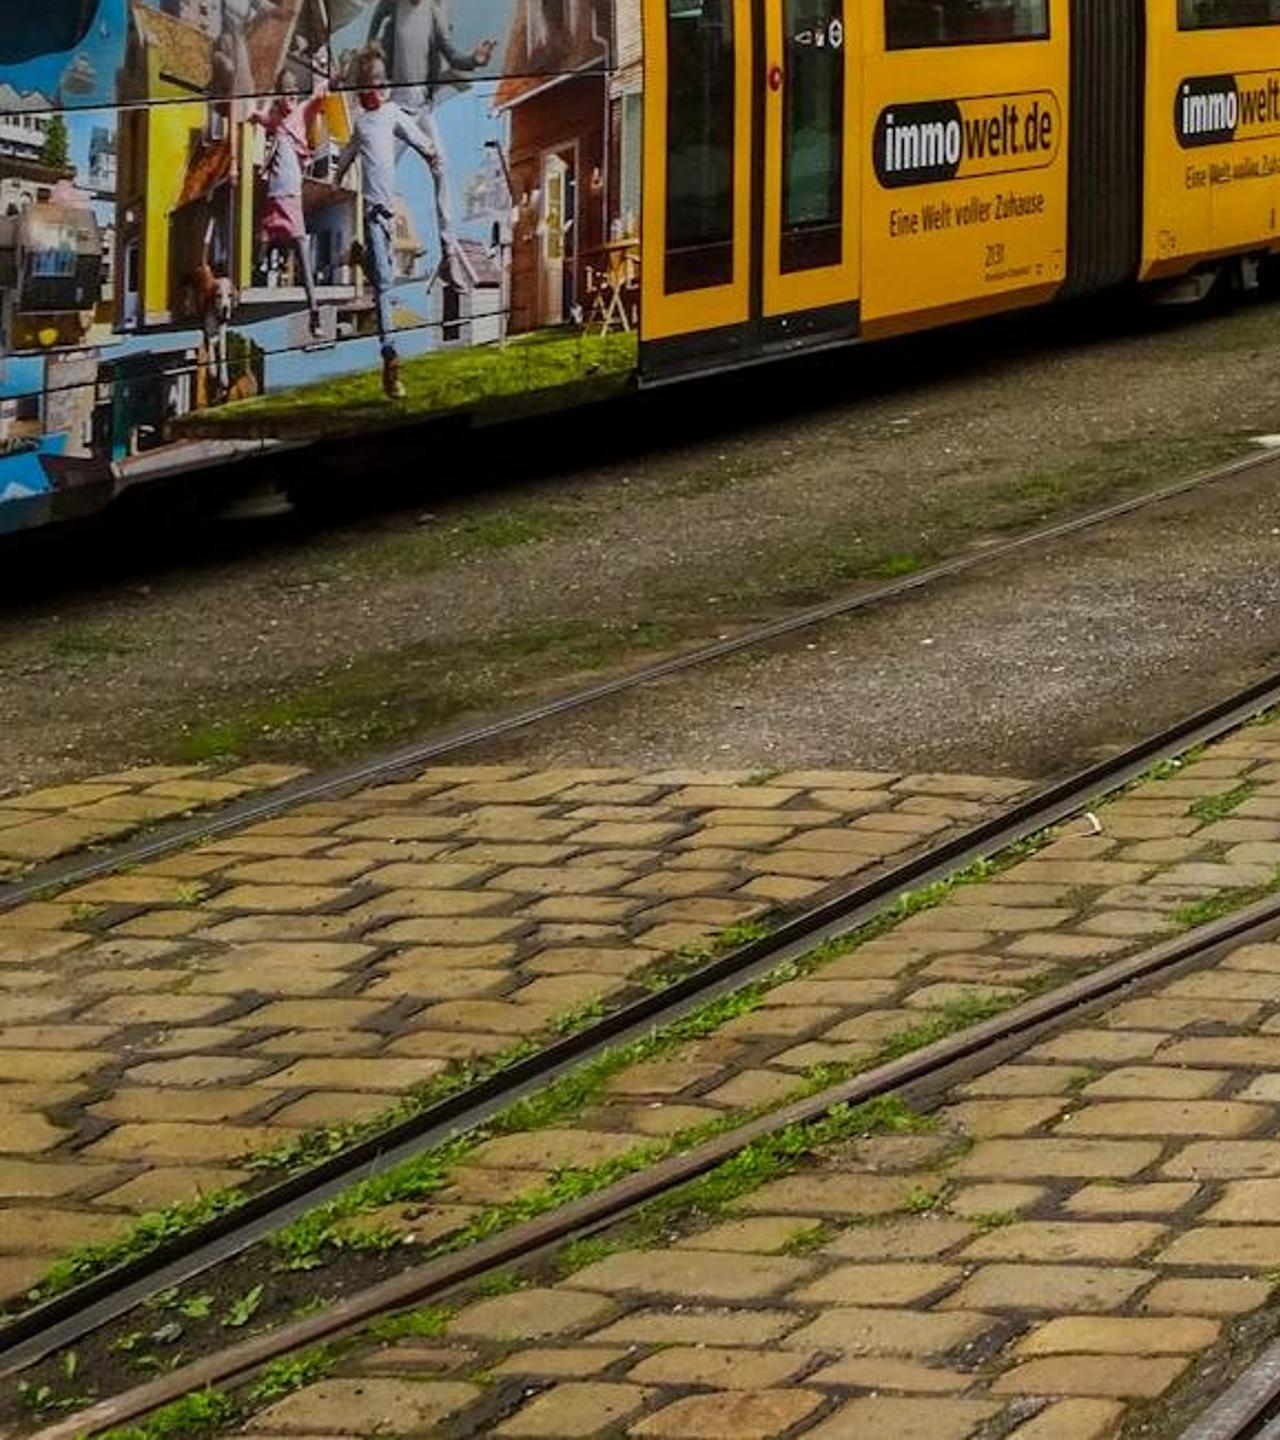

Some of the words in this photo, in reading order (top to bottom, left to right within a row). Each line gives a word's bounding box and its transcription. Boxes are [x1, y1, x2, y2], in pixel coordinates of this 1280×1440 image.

[885, 101, 1052, 172] immowelt.de
[889, 208, 918, 238] Eine
[921, 199, 951, 232] Welt
[954, 195, 992, 227] voller
[994, 191, 1045, 220] Zuhause
